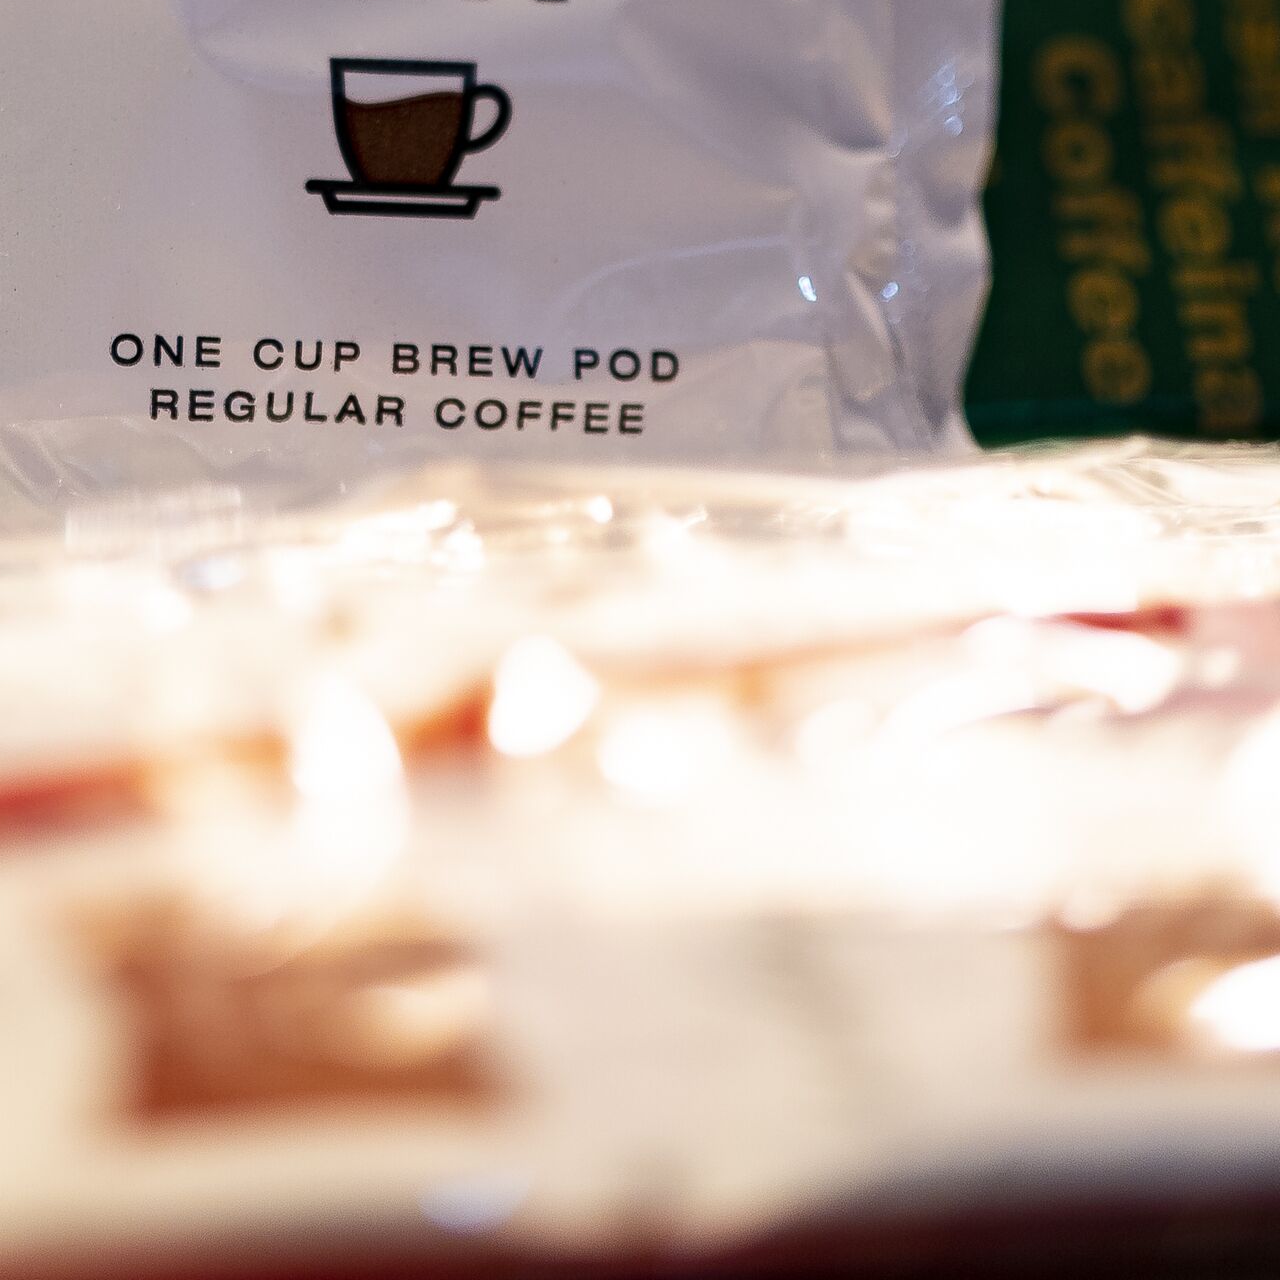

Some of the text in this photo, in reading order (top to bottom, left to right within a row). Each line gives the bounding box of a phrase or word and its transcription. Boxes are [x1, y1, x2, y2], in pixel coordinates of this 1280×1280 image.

[1032, 37, 1152, 405] Coffee
[110, 333, 680, 383] ONE CUP BREW POD
[149, 388, 645, 435] REGULAR COFFEE
